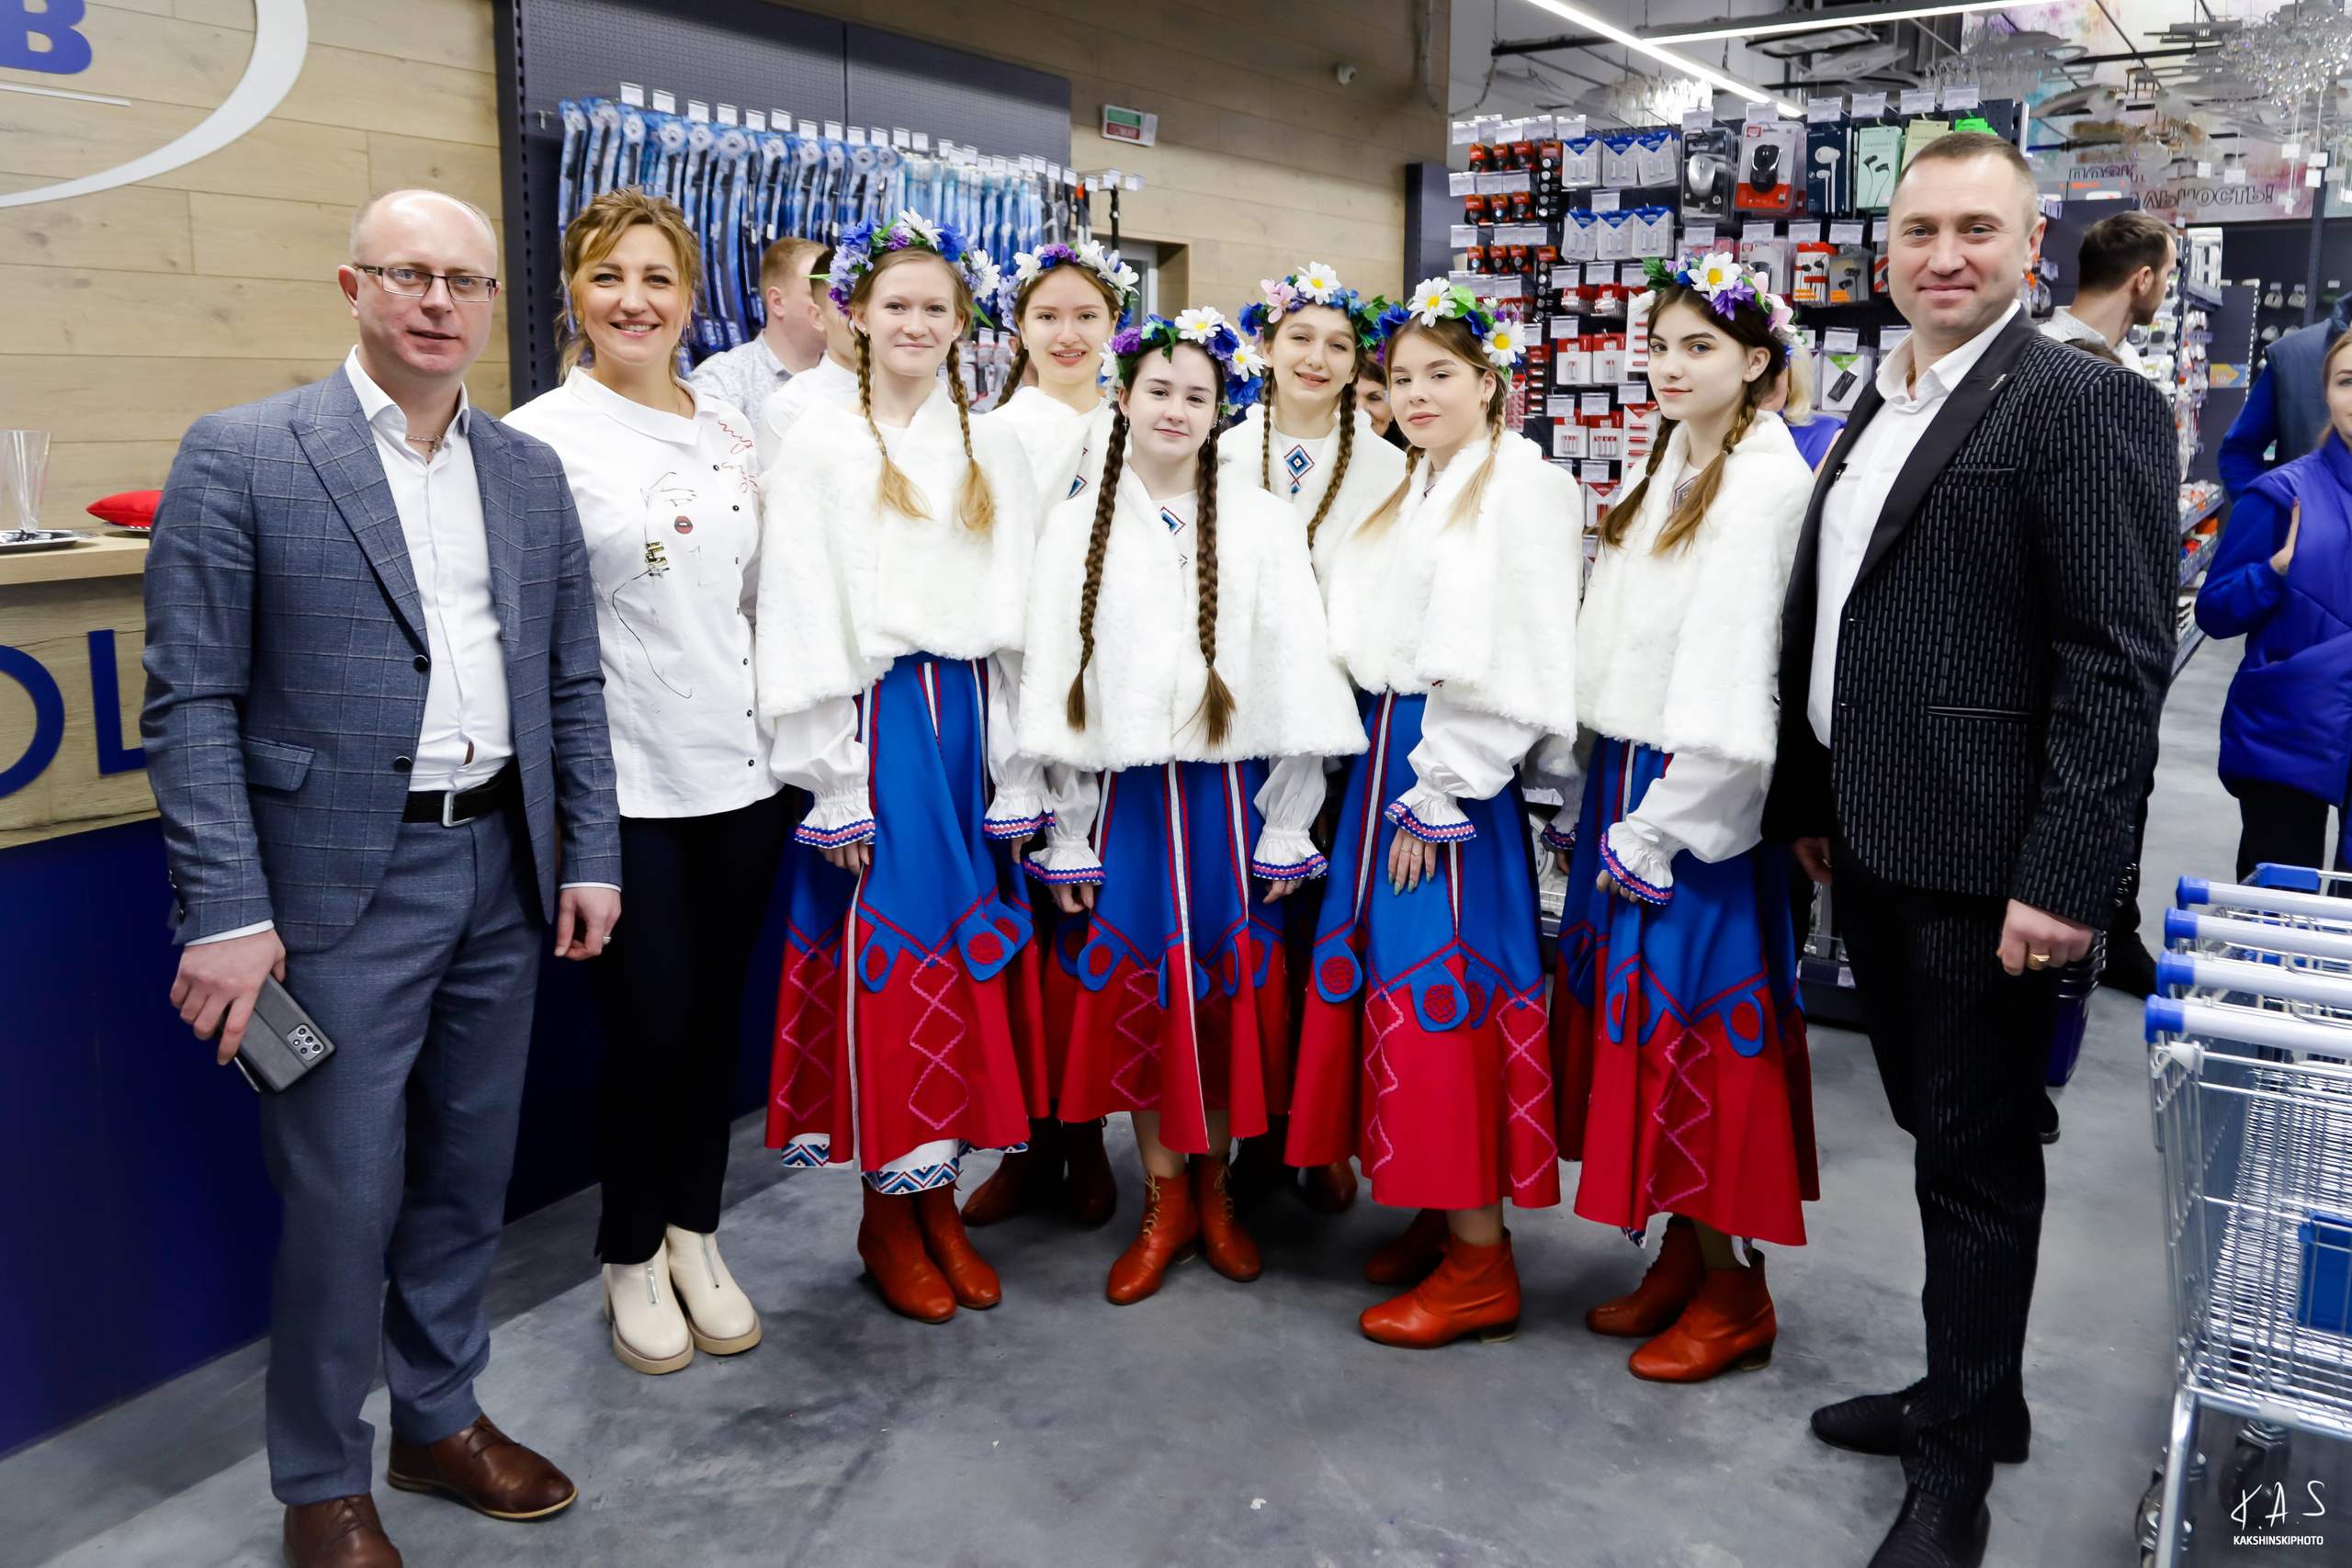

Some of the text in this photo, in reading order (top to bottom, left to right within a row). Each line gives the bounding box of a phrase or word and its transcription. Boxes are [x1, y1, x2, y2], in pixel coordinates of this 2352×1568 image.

[1566, 343, 1579, 351] ONE
[1603, 341, 1617, 350] ONE
[1600, 419, 1612, 427] ONE
